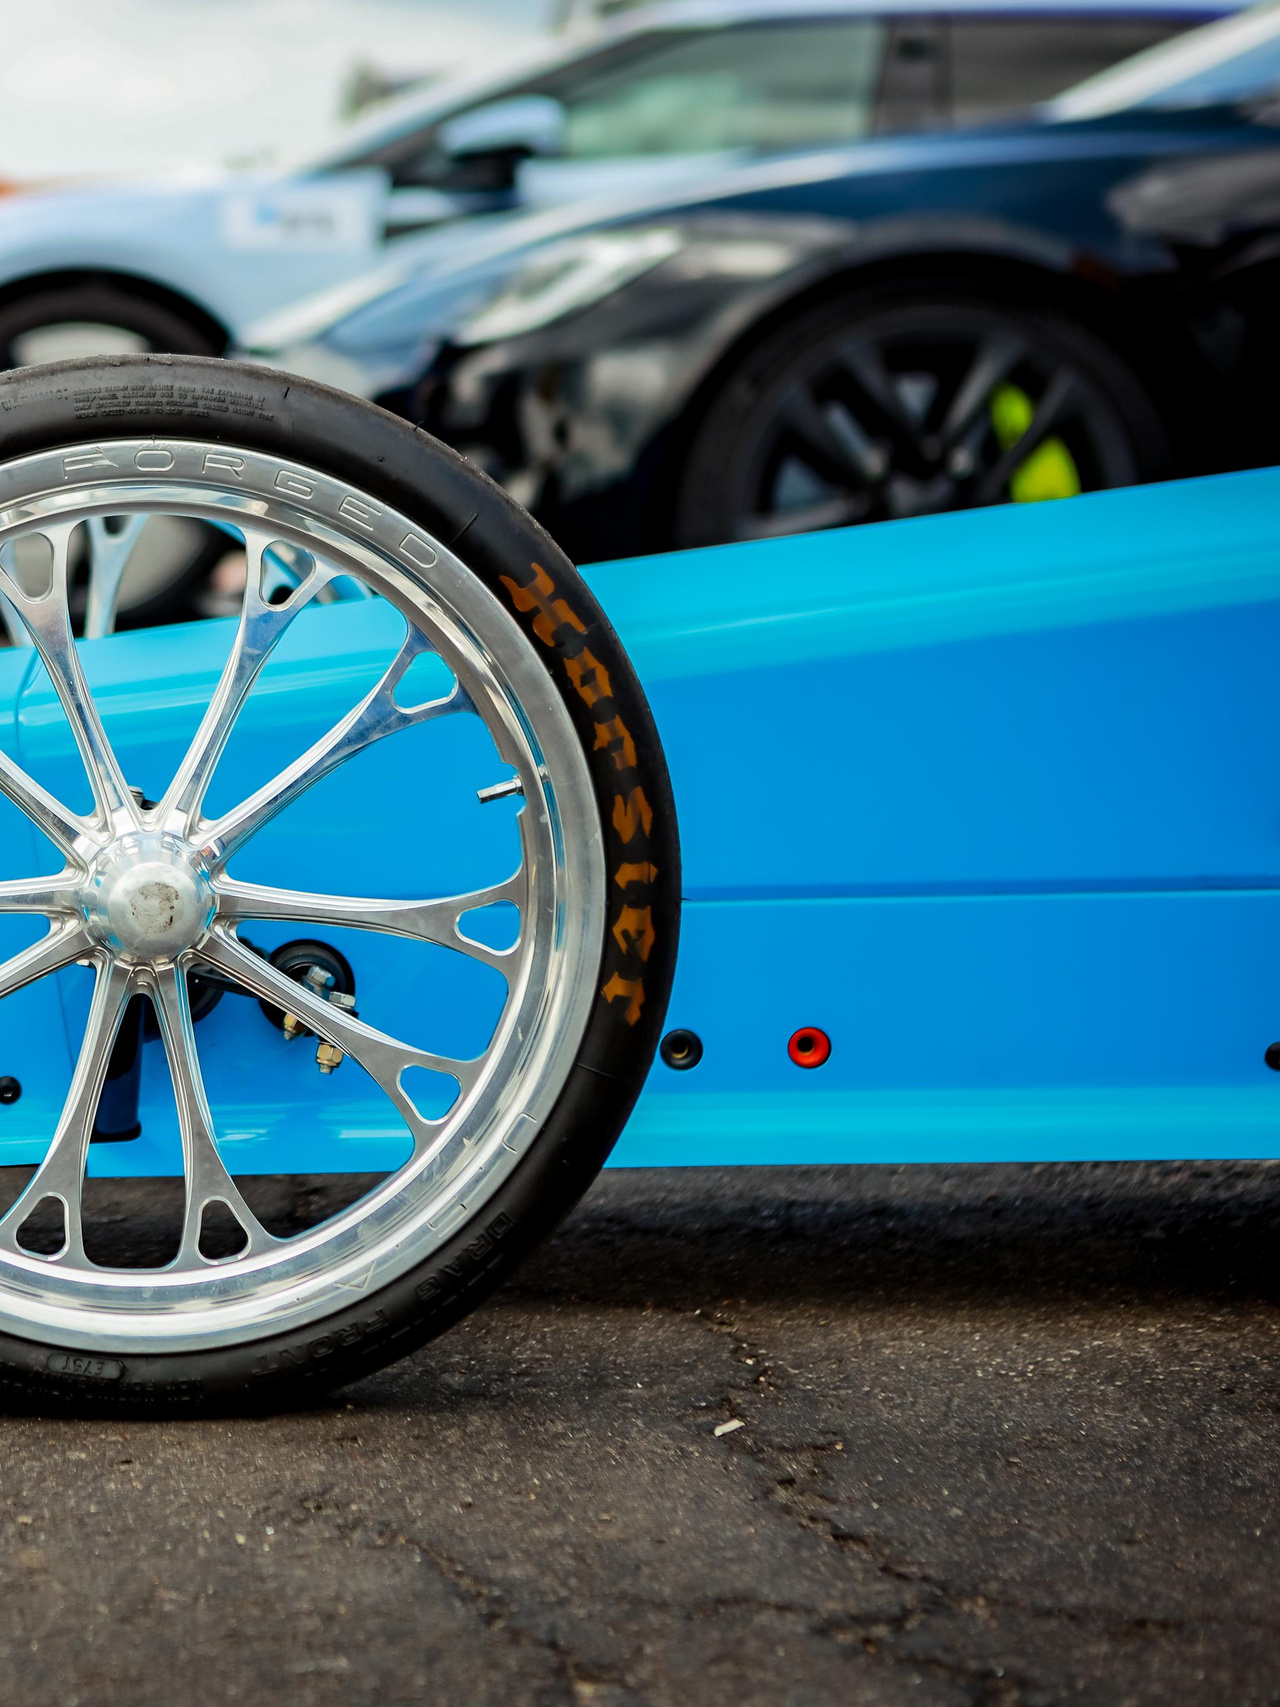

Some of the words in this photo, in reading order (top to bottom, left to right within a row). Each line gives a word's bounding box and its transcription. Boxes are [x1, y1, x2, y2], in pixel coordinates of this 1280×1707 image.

[74, 403, 92, 411] ONLY
[203, 403, 229, 413] SHOULD
[232, 407, 255, 418] MOUNT
[178, 392, 187, 400] TO
[192, 393, 226, 404] IMPROPER
[201, 387, 215, 395] THE
[217, 388, 253, 401] EXPLOSION
[257, 395, 266, 403] OF
[61, 447, 440, 569] FORGED
[415, 1208, 514, 1300] DRAG
[250, 1307, 391, 1377] FRONT
